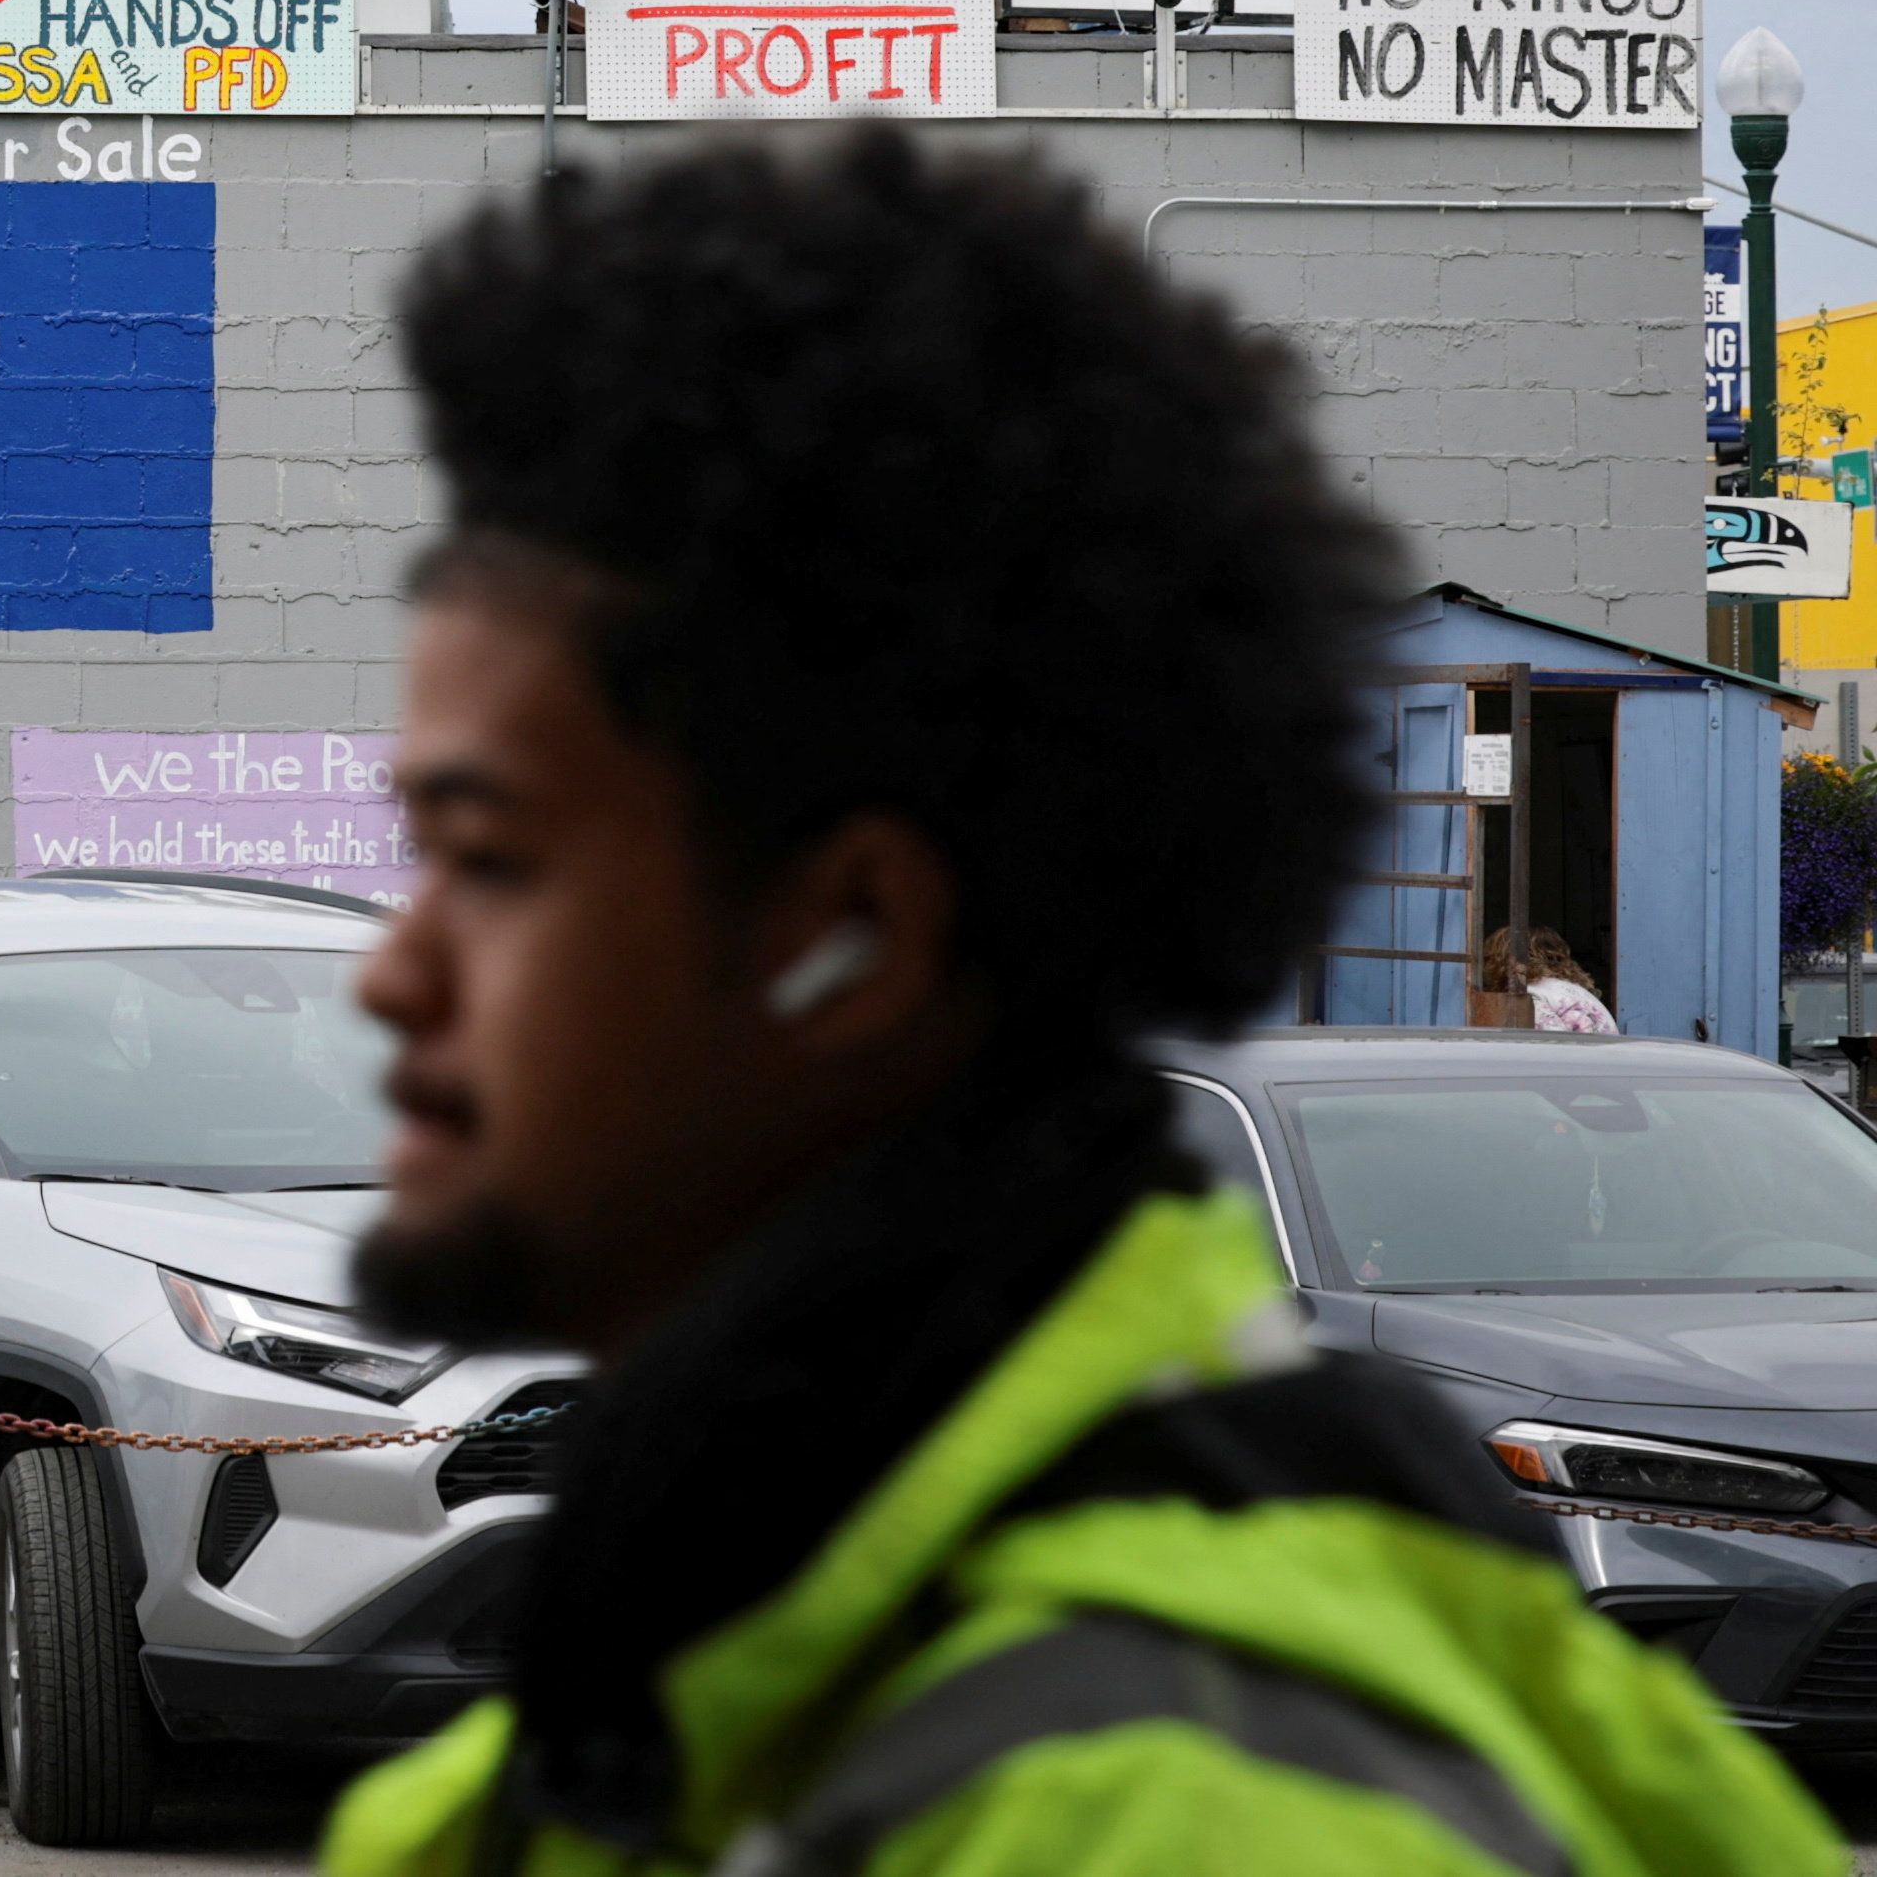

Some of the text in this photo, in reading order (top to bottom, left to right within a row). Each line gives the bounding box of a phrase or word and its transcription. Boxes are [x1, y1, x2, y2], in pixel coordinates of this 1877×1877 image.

[110, 49, 159, 98] and
[183, 46, 288, 111] PFD
[665, 23, 960, 105] PROFIT
[1339, 21, 1697, 120] NO MASTER
[55, 114, 203, 183] Sale
[208, 733, 304, 794] the
[323, 733, 405, 802] Peo
[109, 815, 183, 866] hold
[195, 822, 286, 865] these
[291, 819, 378, 866] truths
